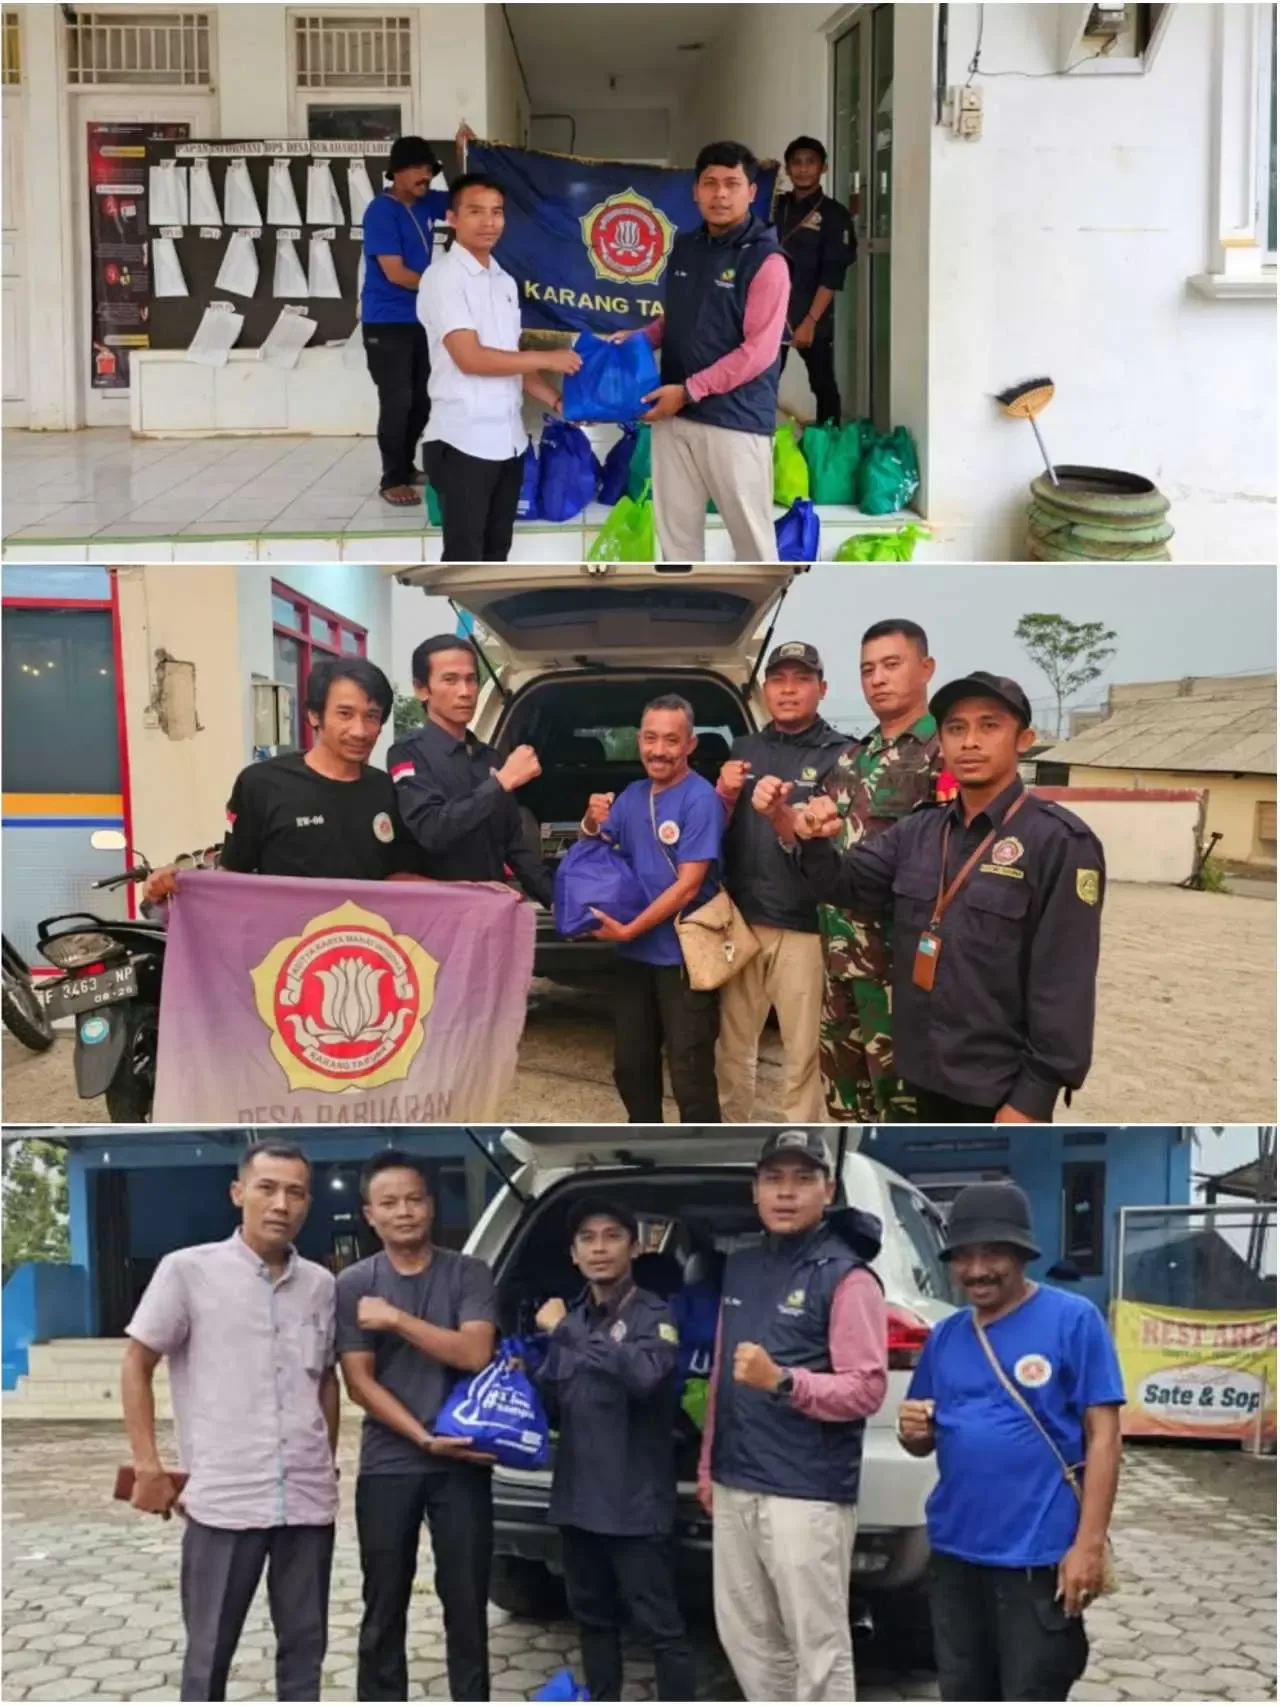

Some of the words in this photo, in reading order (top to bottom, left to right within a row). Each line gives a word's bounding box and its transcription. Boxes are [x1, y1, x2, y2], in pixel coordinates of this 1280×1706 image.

[524, 280, 629, 314] KARANG
[115, 966, 133, 983] NP
[1144, 1383, 1194, 1406] Sate
[1198, 1386, 1215, 1407] &
